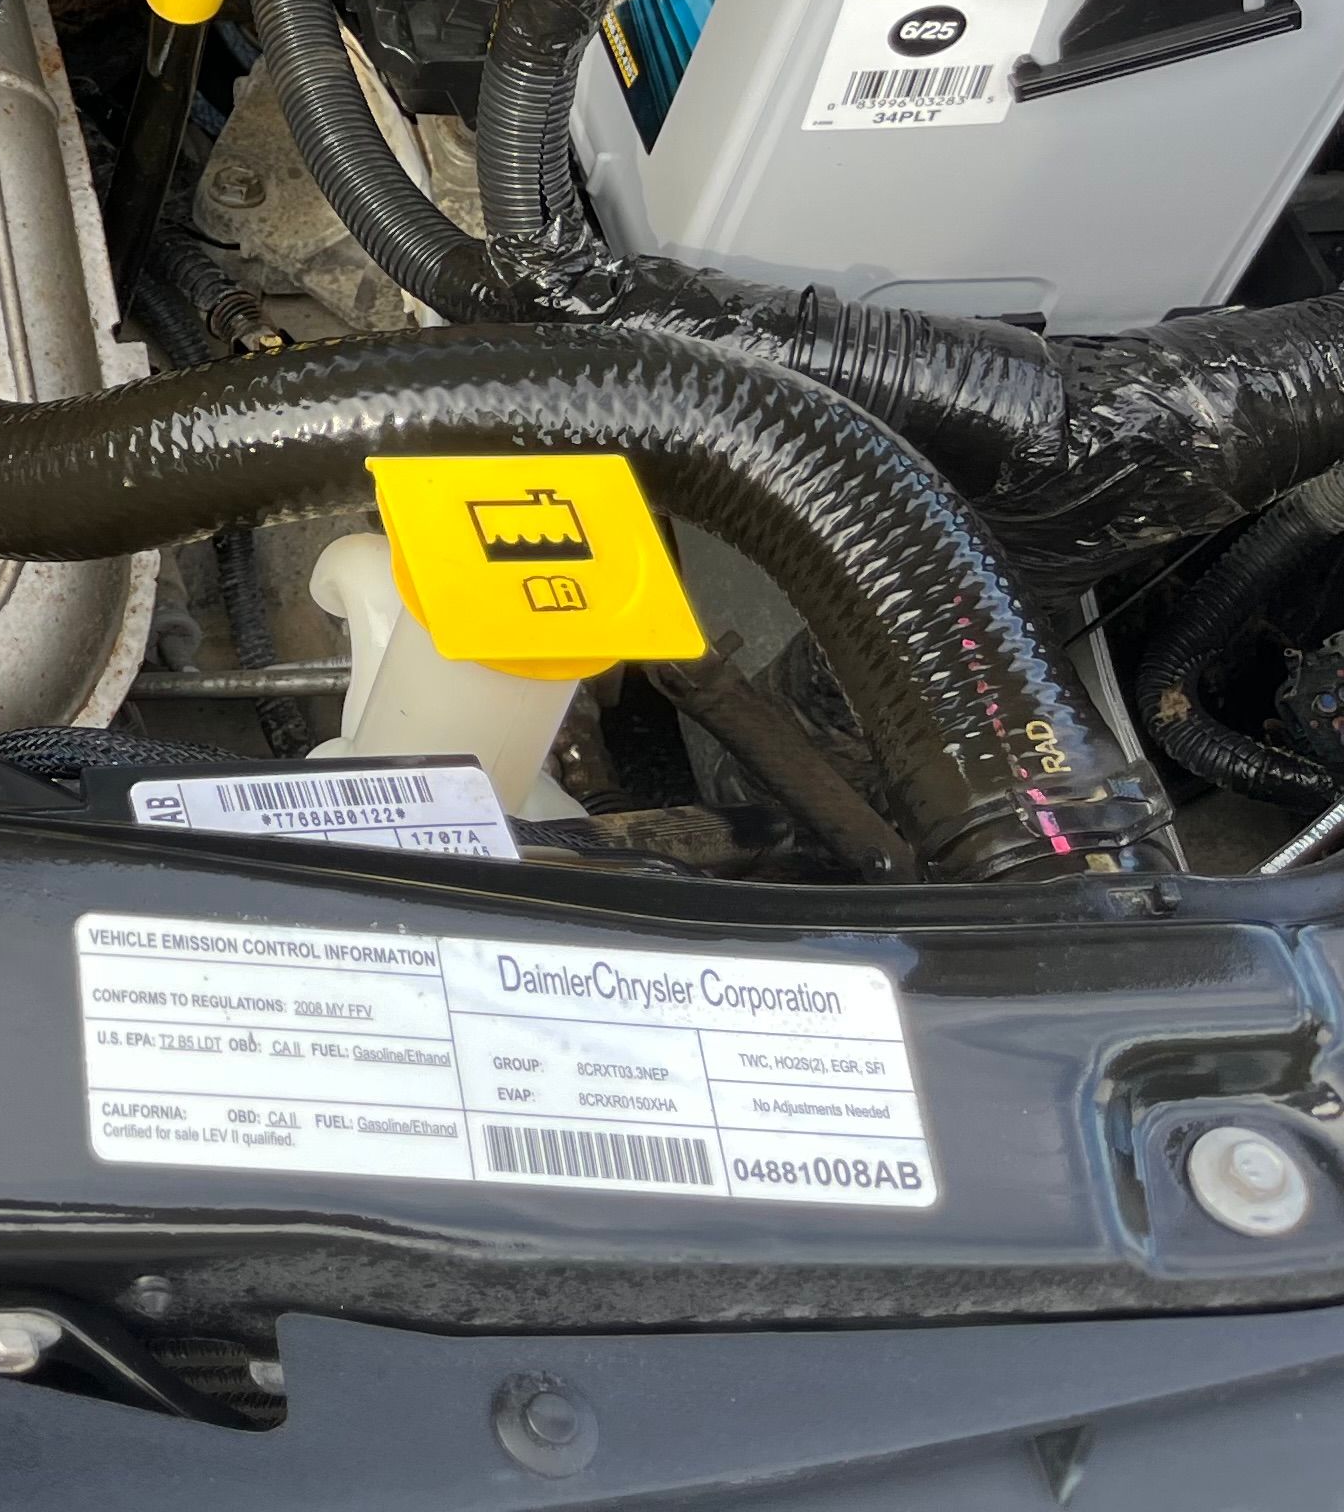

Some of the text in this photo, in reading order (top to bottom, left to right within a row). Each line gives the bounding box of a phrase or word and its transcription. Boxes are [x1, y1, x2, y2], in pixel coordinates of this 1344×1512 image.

[899, 21, 958, 40] 6/25
[872, 109, 942, 124] 34PLT
[1025, 720, 1071, 774] RAD
[145, 795, 185, 824] AB
[89, 928, 436, 967] VEHICLE EMISSION CONTROL INFORMATION
[497, 954, 841, 1017] DaimlerChrysler Corporation
[93, 988, 372, 1018] CONFORMS TO REGULATIONS: 2008 MY FFV
[98, 1030, 123, 1046] U.S.
[126, 1033, 156, 1047] EPA:
[159, 1034, 175, 1048] T2
[178, 1035, 194, 1050] B5
[197, 1037, 222, 1051] LDT
[228, 1037, 262, 1053] OBD:
[272, 1041, 291, 1056] CA
[311, 1043, 350, 1059] FUEL:
[353, 1046, 451, 1067] Gasoline/Ethanol
[493, 1056, 545, 1073] GROUP:
[738, 1052, 772, 1070] TWC,
[831, 1059, 864, 1076] EGR,
[865, 1060, 885, 1075] SFI
[497, 1088, 536, 1103] EVAP:
[752, 1097, 890, 1120] No Adjustments Needed
[102, 1102, 187, 1121] CALIFORNIA:
[227, 1109, 261, 1125] OBD:
[268, 1112, 287, 1127] CA
[315, 1114, 354, 1131] FUEL:
[357, 1117, 458, 1138] Gasoline/Ethanol
[103, 1123, 153, 1139] Certified
[155, 1127, 171, 1141] for
[175, 1129, 200, 1143] sale
[203, 1128, 228, 1143] LEV
[242, 1131, 296, 1149] qualified.
[733, 1156, 922, 1191] 04881008AB
